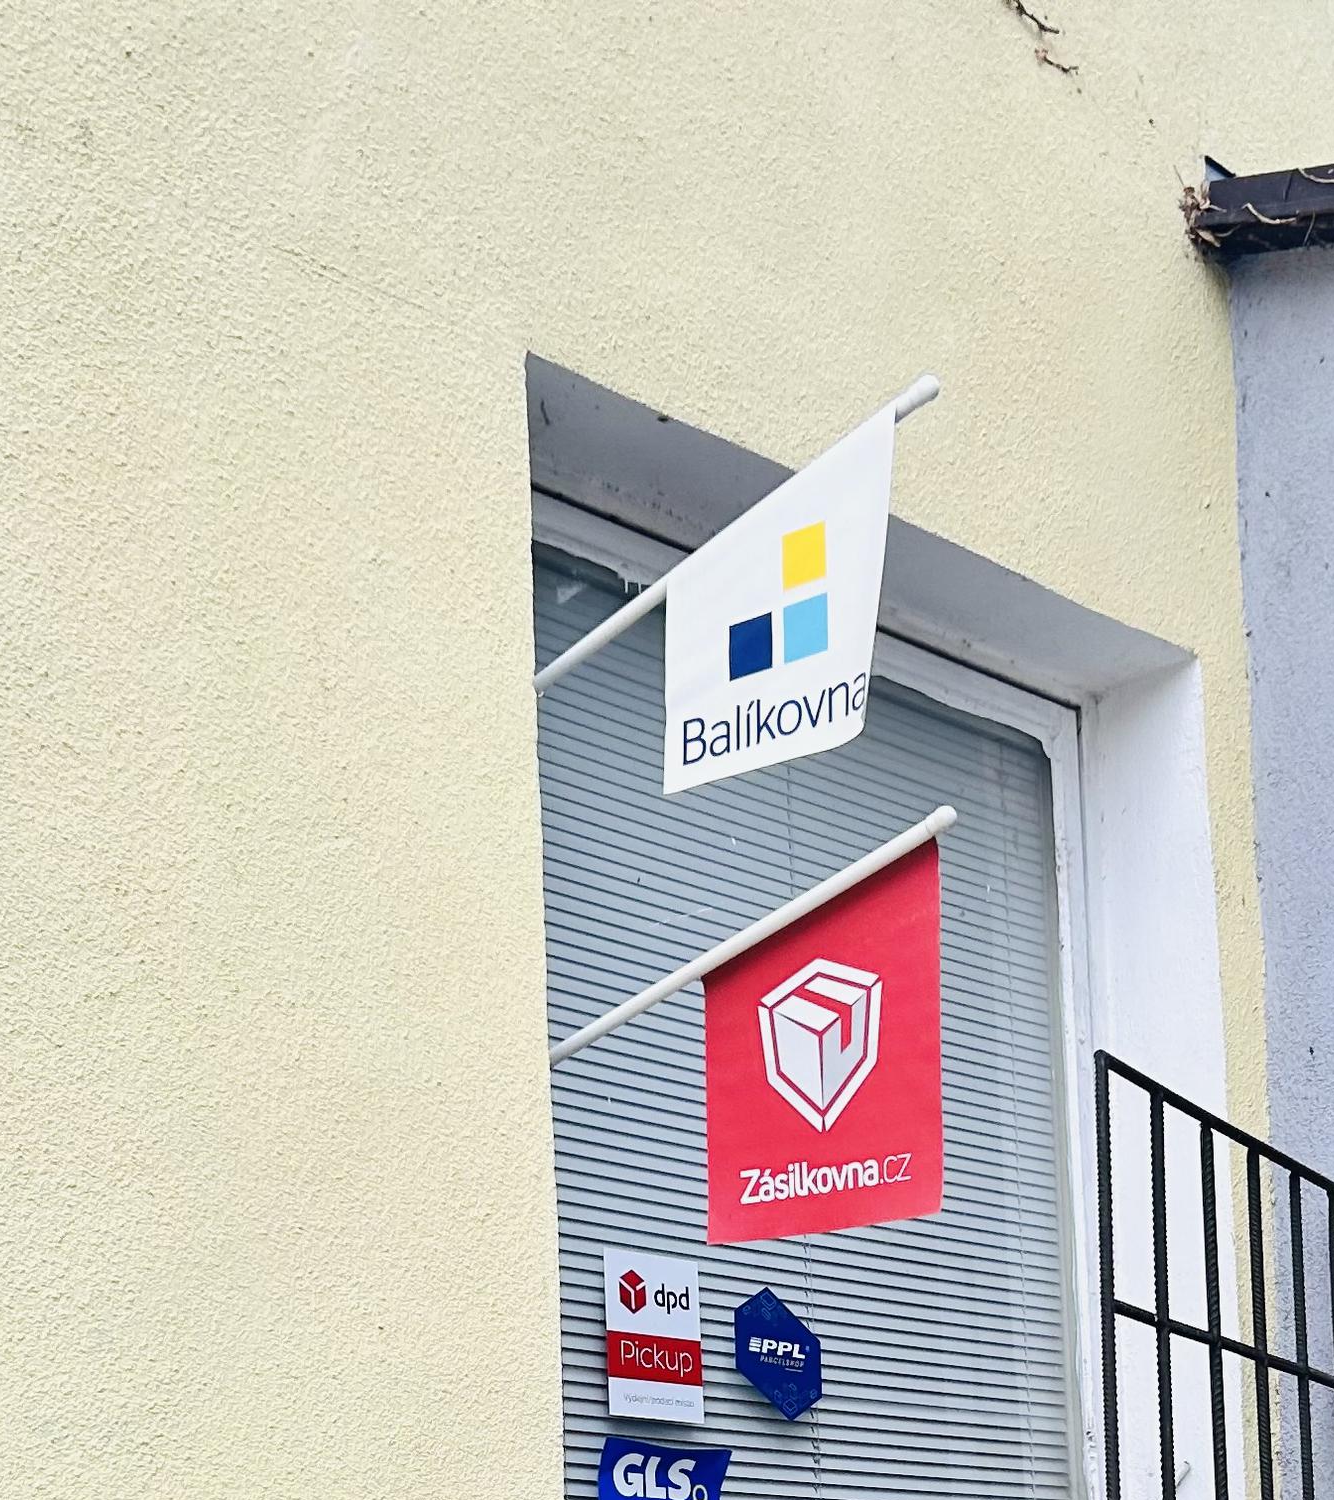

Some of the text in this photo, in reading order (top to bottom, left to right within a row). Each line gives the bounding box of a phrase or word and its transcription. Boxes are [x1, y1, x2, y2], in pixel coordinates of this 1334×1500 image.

[682, 672, 867, 767] Balíkovna
[739, 1152, 912, 1206] Zásilkovna.cz
[653, 1282, 691, 1315] dpd
[620, 1339, 693, 1378] Pickup
[761, 1338, 806, 1360] PPL
[612, 1452, 697, 1500] GLS
